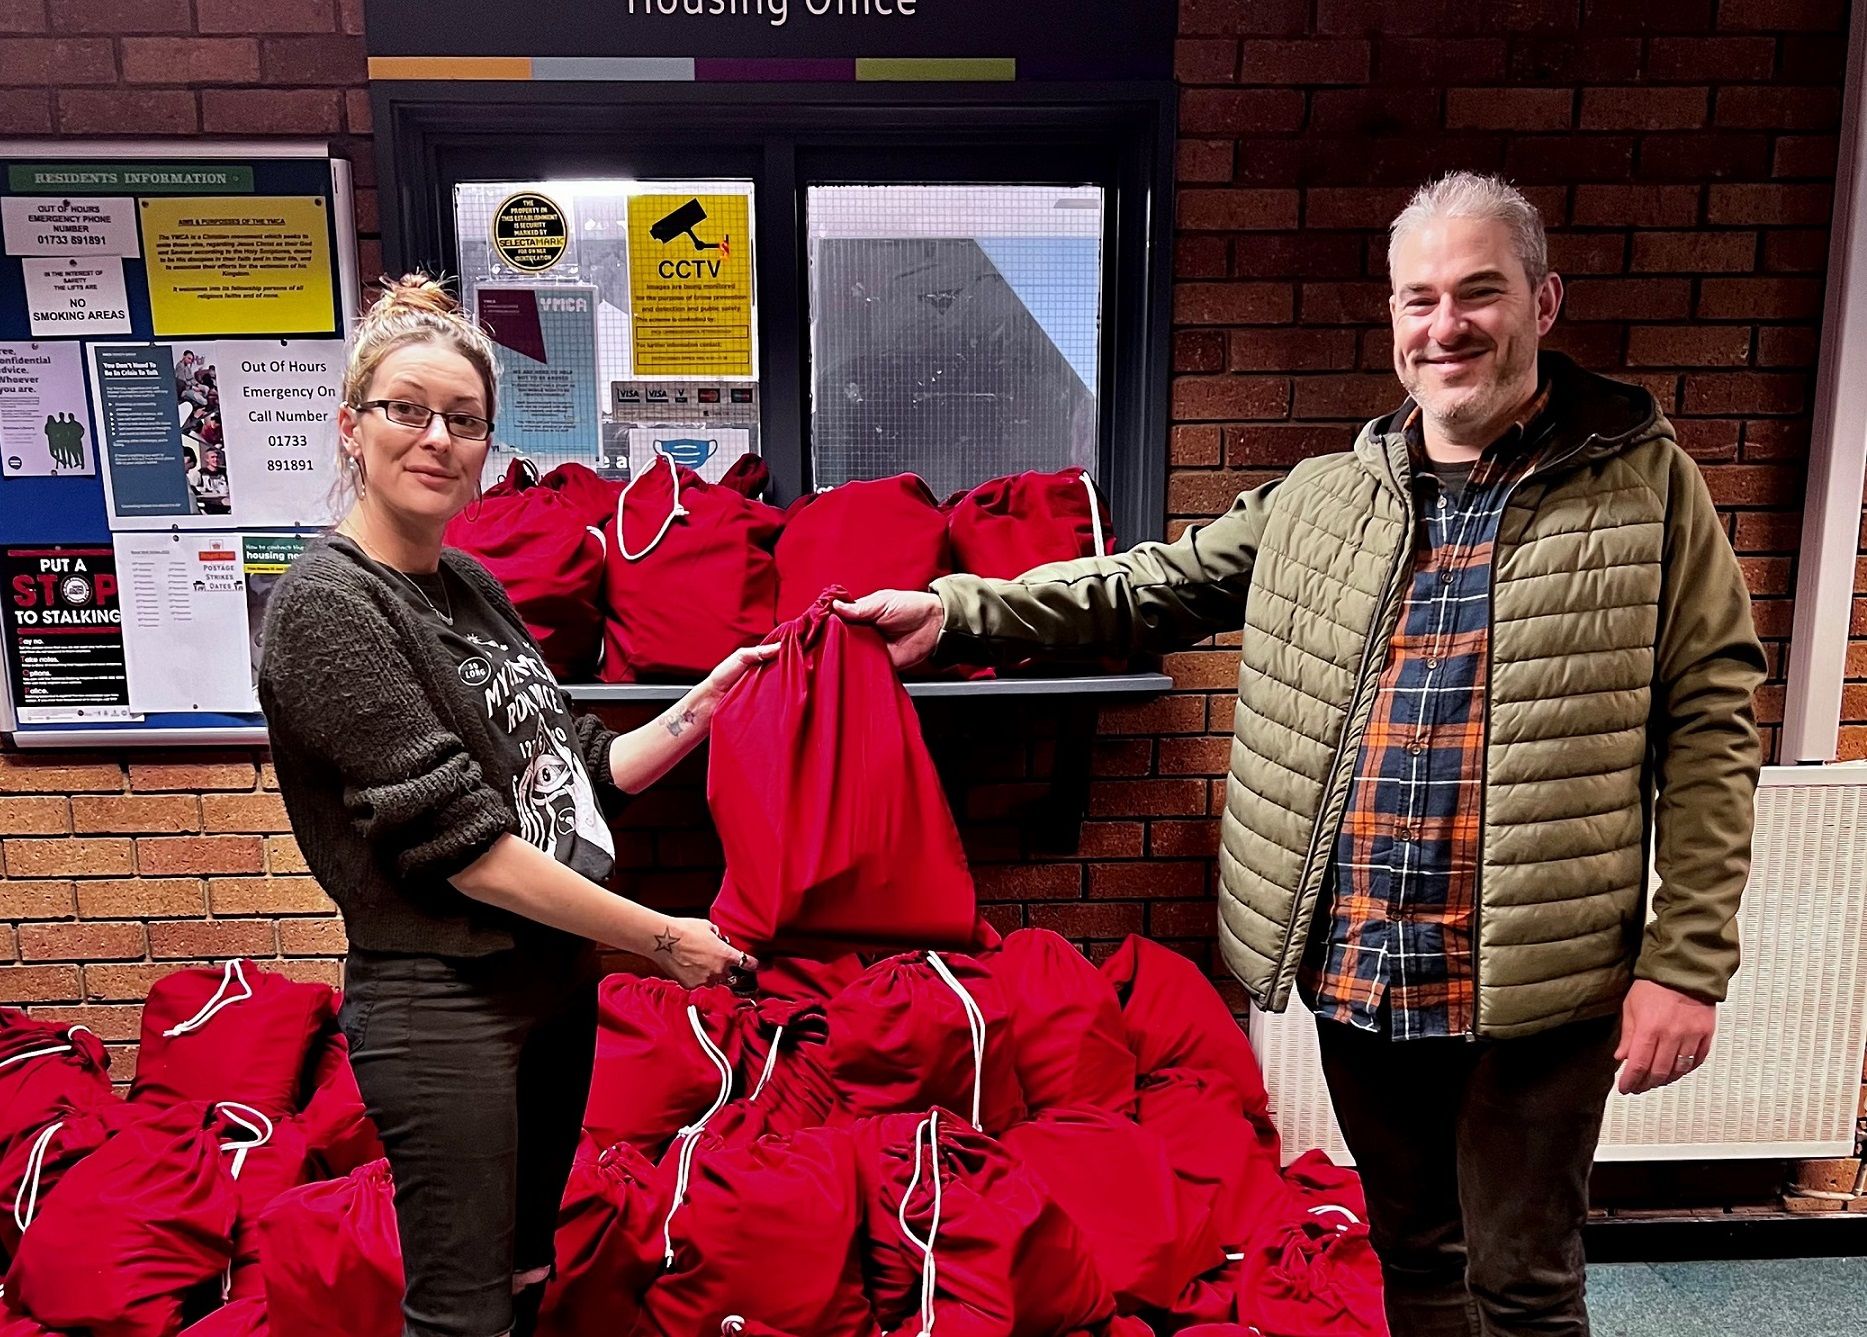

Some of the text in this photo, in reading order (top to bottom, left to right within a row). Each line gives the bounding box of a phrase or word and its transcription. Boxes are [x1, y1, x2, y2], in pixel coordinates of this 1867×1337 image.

[34, 172, 226, 184] RESIDENTS INFORMATION
[37, 205, 100, 214] OUT OF HOURS
[28, 216, 81, 224] EMERGENCY
[53, 225, 89, 233] NUMBER
[37, 235, 107, 245] 01733 891891
[499, 237, 565, 247] SELECTAMARK
[658, 260, 721, 278] CCTV
[69, 298, 86, 308] NO
[540, 297, 587, 312] YMCA
[33, 310, 125, 321] SMOKING AREAS
[0, 356, 51, 365] onfidential
[0, 366, 29, 374] dvice.
[241, 360, 327, 373] Out Of Hours
[242, 385, 335, 400] Emergency On
[248, 410, 328, 422] Call Number
[268, 435, 307, 447] 01733
[267, 459, 314, 471] 891891
[246, 551, 285, 561] housing
[40, 558, 87, 572] PUT A
[14, 609, 121, 625] TO STALKING
